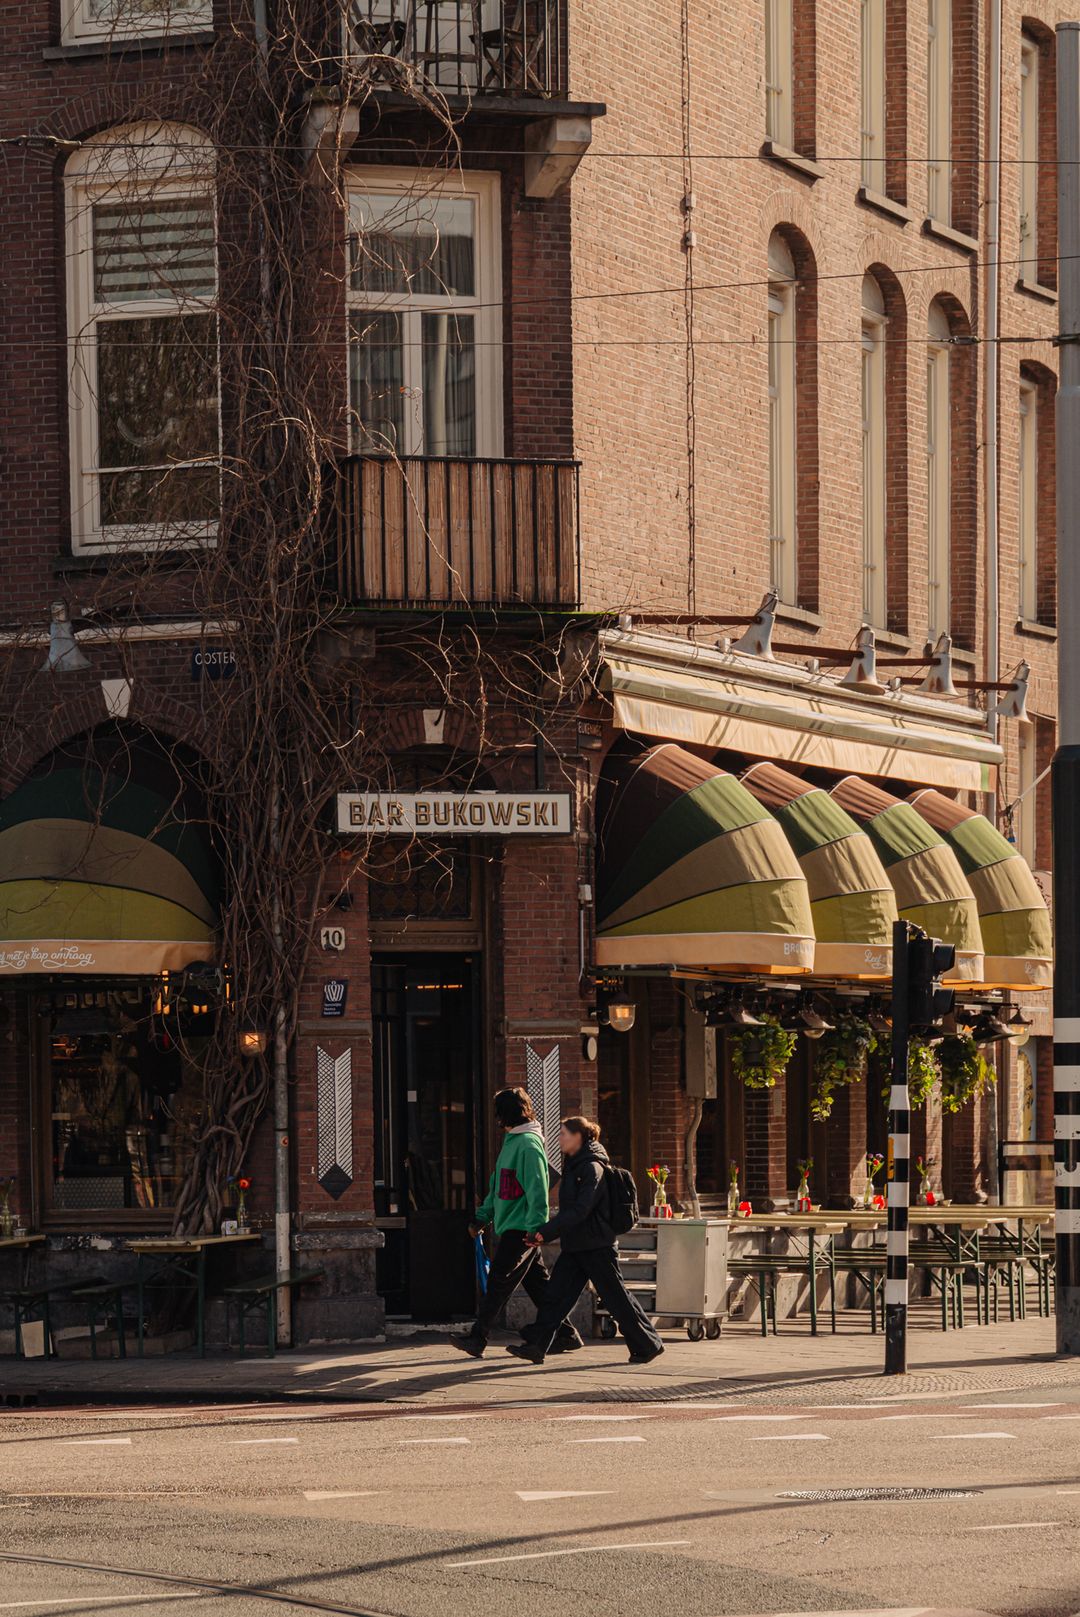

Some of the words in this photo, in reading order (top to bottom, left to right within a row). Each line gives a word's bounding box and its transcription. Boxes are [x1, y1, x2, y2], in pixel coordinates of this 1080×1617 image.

[349, 801, 403, 826] BAR
[415, 801, 558, 826] BUKOWSKI
[323, 930, 342, 947] 10
